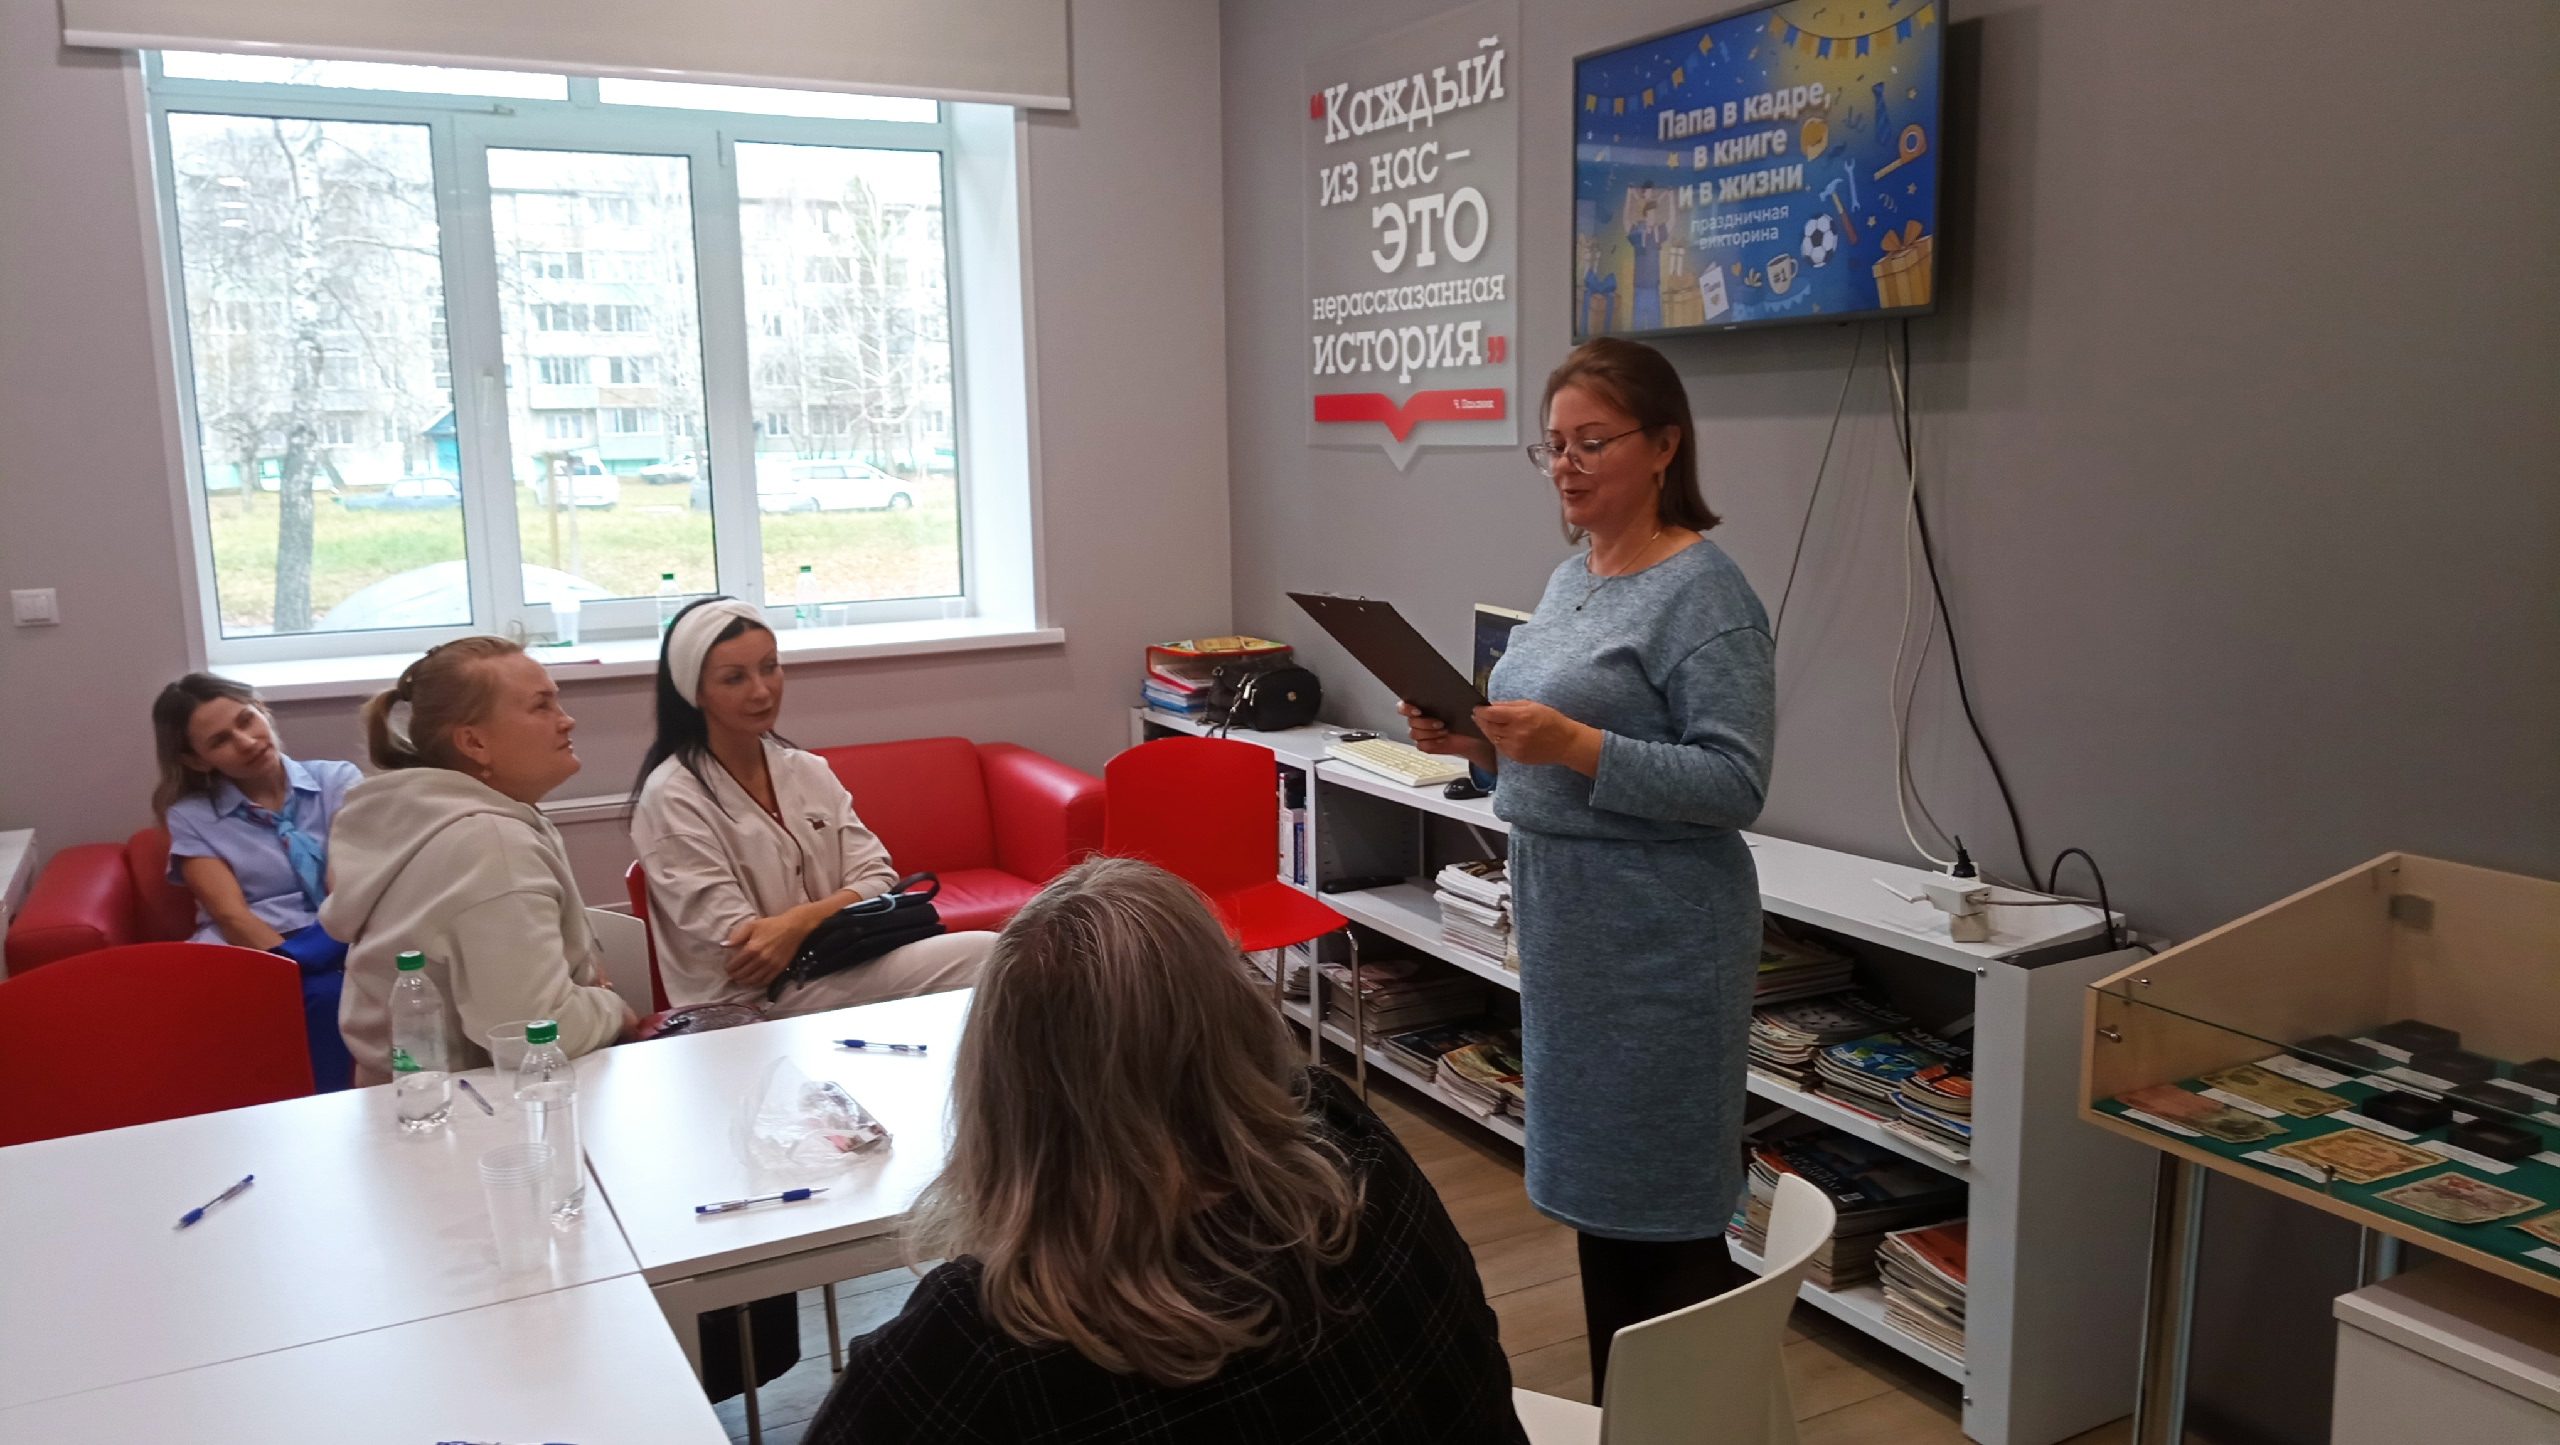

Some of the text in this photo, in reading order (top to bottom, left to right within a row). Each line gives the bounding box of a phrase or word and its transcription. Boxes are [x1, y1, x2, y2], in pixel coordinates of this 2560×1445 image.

[1658, 82, 1831, 141] Папа в кадре,
[1694, 128, 1788, 169] в книге
[1320, 161, 1359, 207] из
[1370, 141, 1439, 194] нас
[1679, 163, 1804, 209] и в жизни
[1372, 186, 1489, 273] ЭТО
[1690, 205, 1790, 235] праздничная
[1699, 227, 1779, 250] викторина
[1312, 274, 1505, 325] нерассказанная
